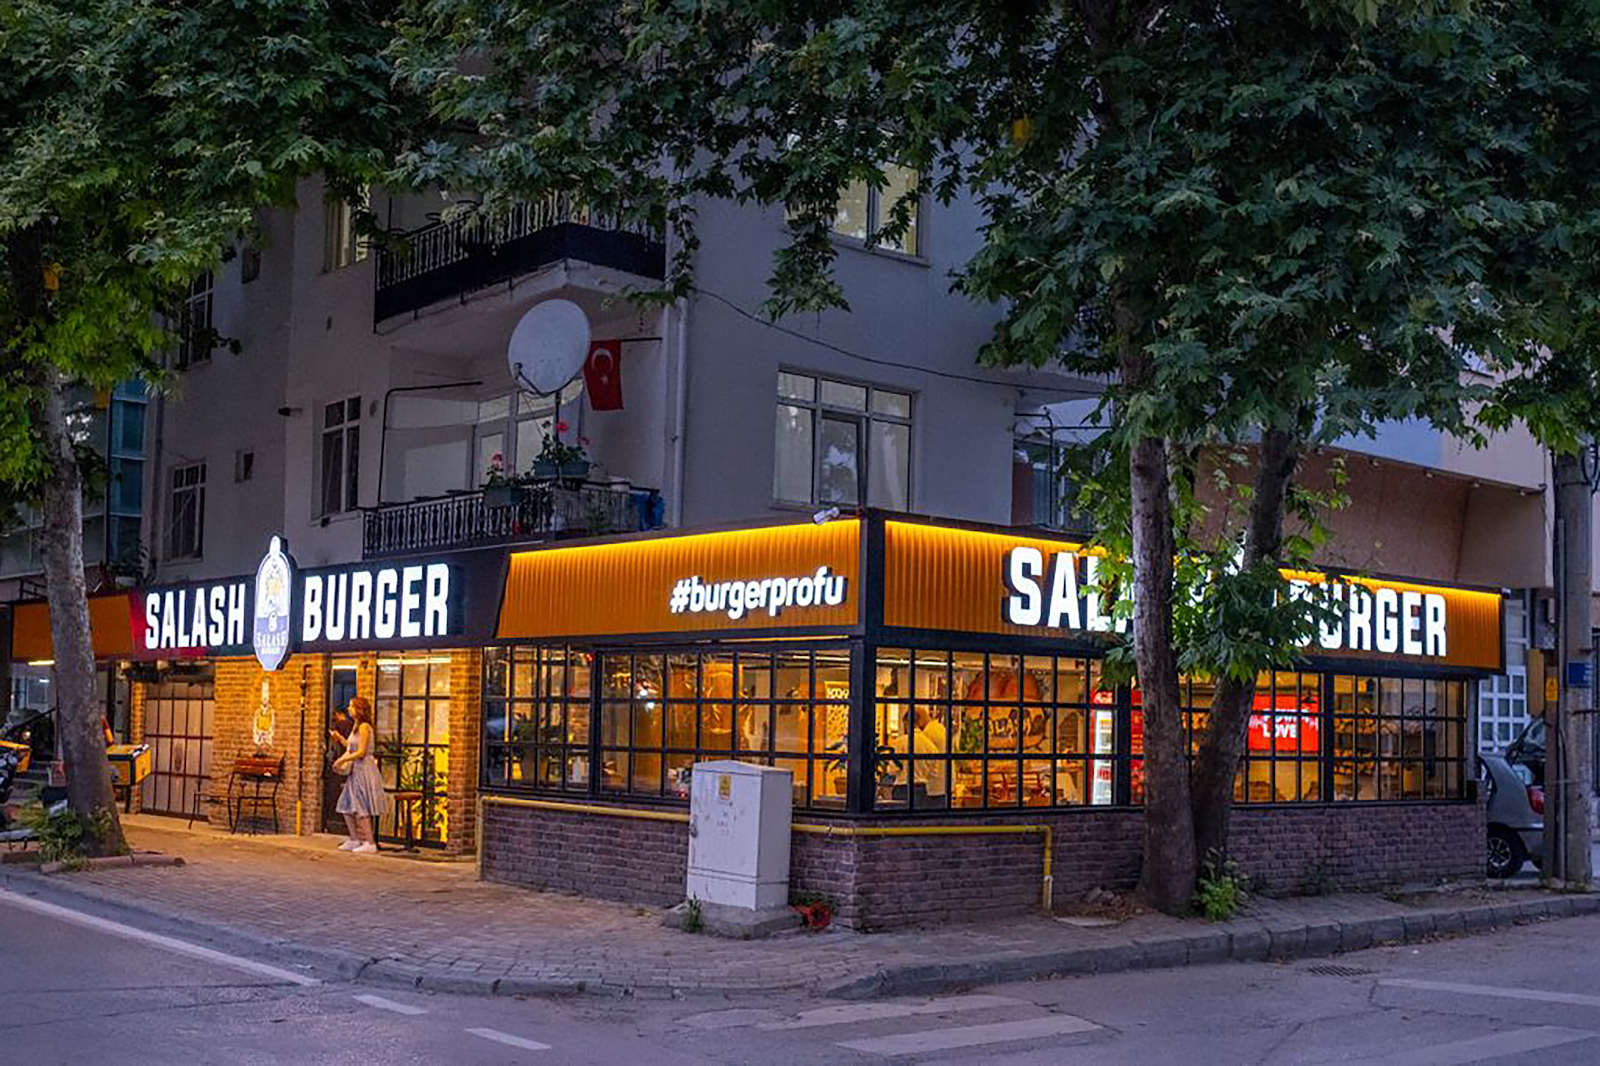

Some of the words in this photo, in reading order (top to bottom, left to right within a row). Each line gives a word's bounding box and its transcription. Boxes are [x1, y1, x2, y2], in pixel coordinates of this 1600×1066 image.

[145, 583, 246, 649] SALASH
[302, 563, 450, 642] BURGER
[670, 566, 845, 619] #burgerprofu
[1262, 724, 1297, 738] LOVE
